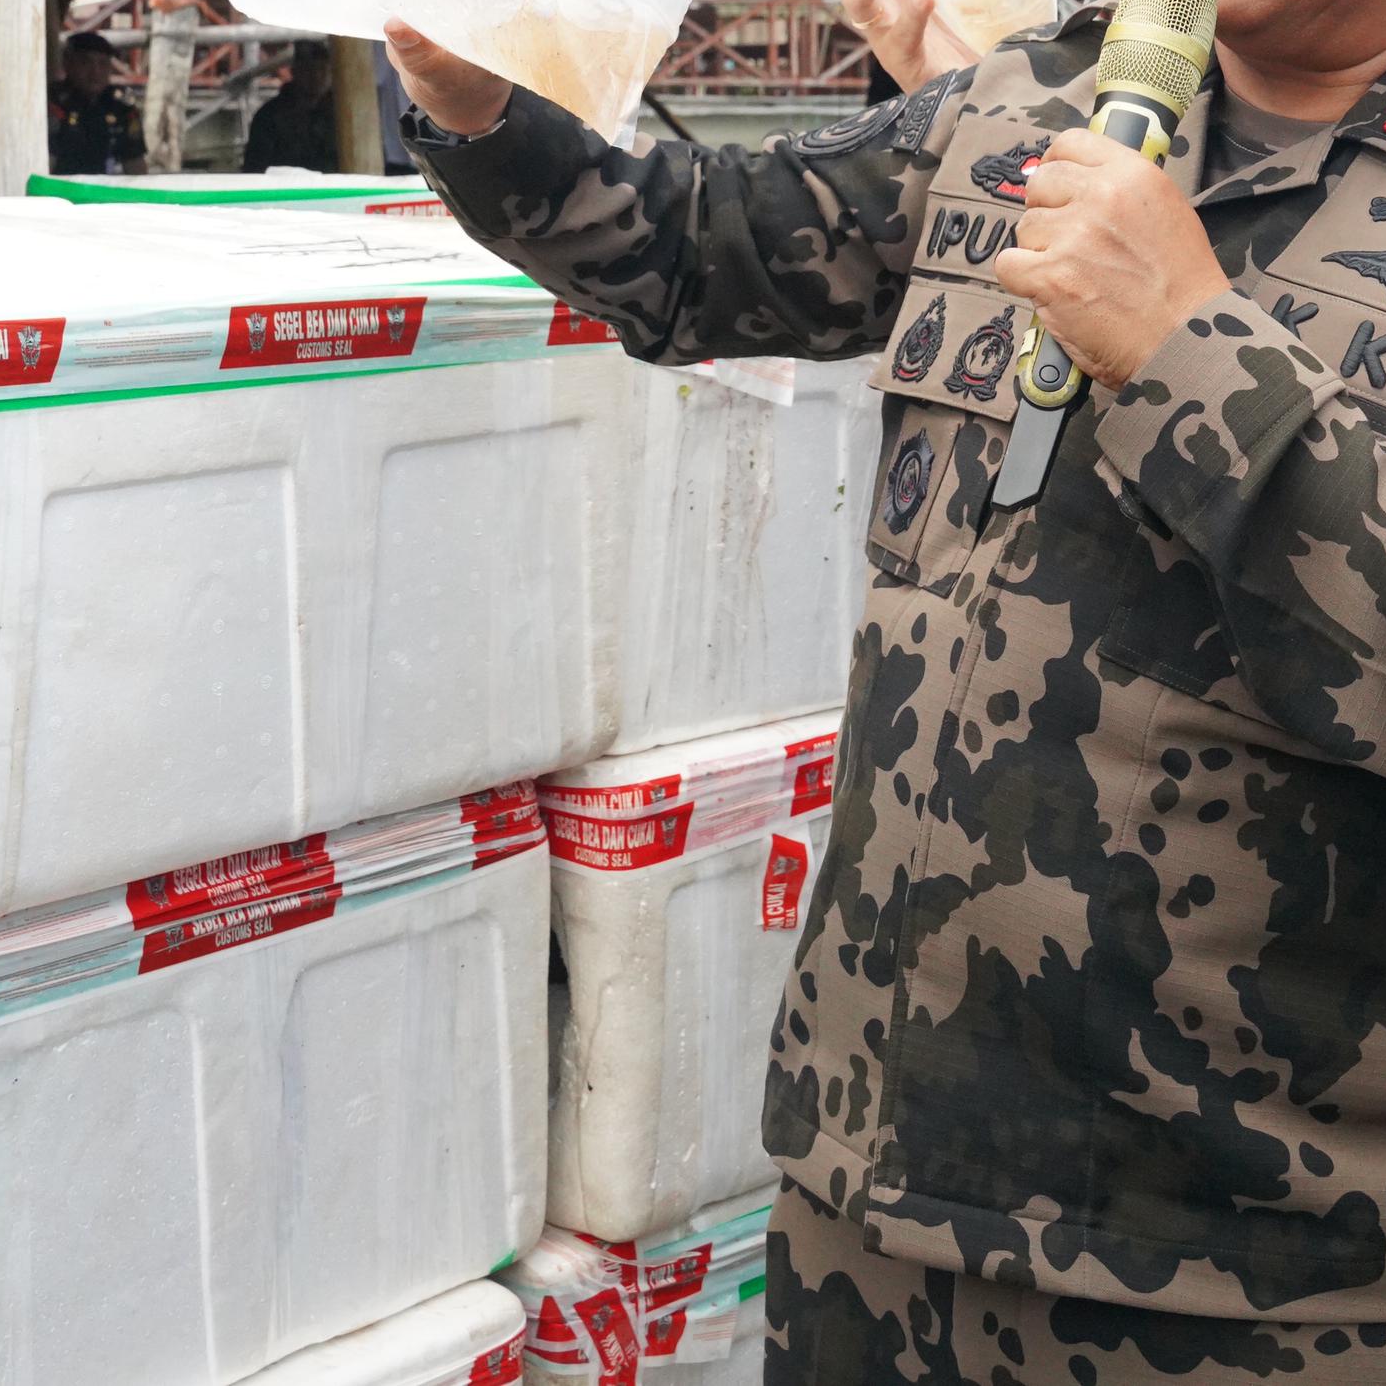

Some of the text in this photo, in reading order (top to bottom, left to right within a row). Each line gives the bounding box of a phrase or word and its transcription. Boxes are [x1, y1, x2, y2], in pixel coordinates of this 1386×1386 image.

[273, 306, 380, 342] SEGEL BEA DAN CUKAI
[296, 339, 353, 359] CUSTOMS SEAL
[554, 814, 581, 844] SEGEL
[582, 822, 601, 849] BEA
[602, 825, 625, 851] DAN
[627, 820, 656, 849] CUKAI
[173, 844, 282, 896] SEGEL BEA DAN CUKAI
[574, 846, 633, 867] CUSTOMS SEAL
[767, 882, 788, 915] CUKAI
[215, 917, 274, 948] CUSTOMS SEAL
